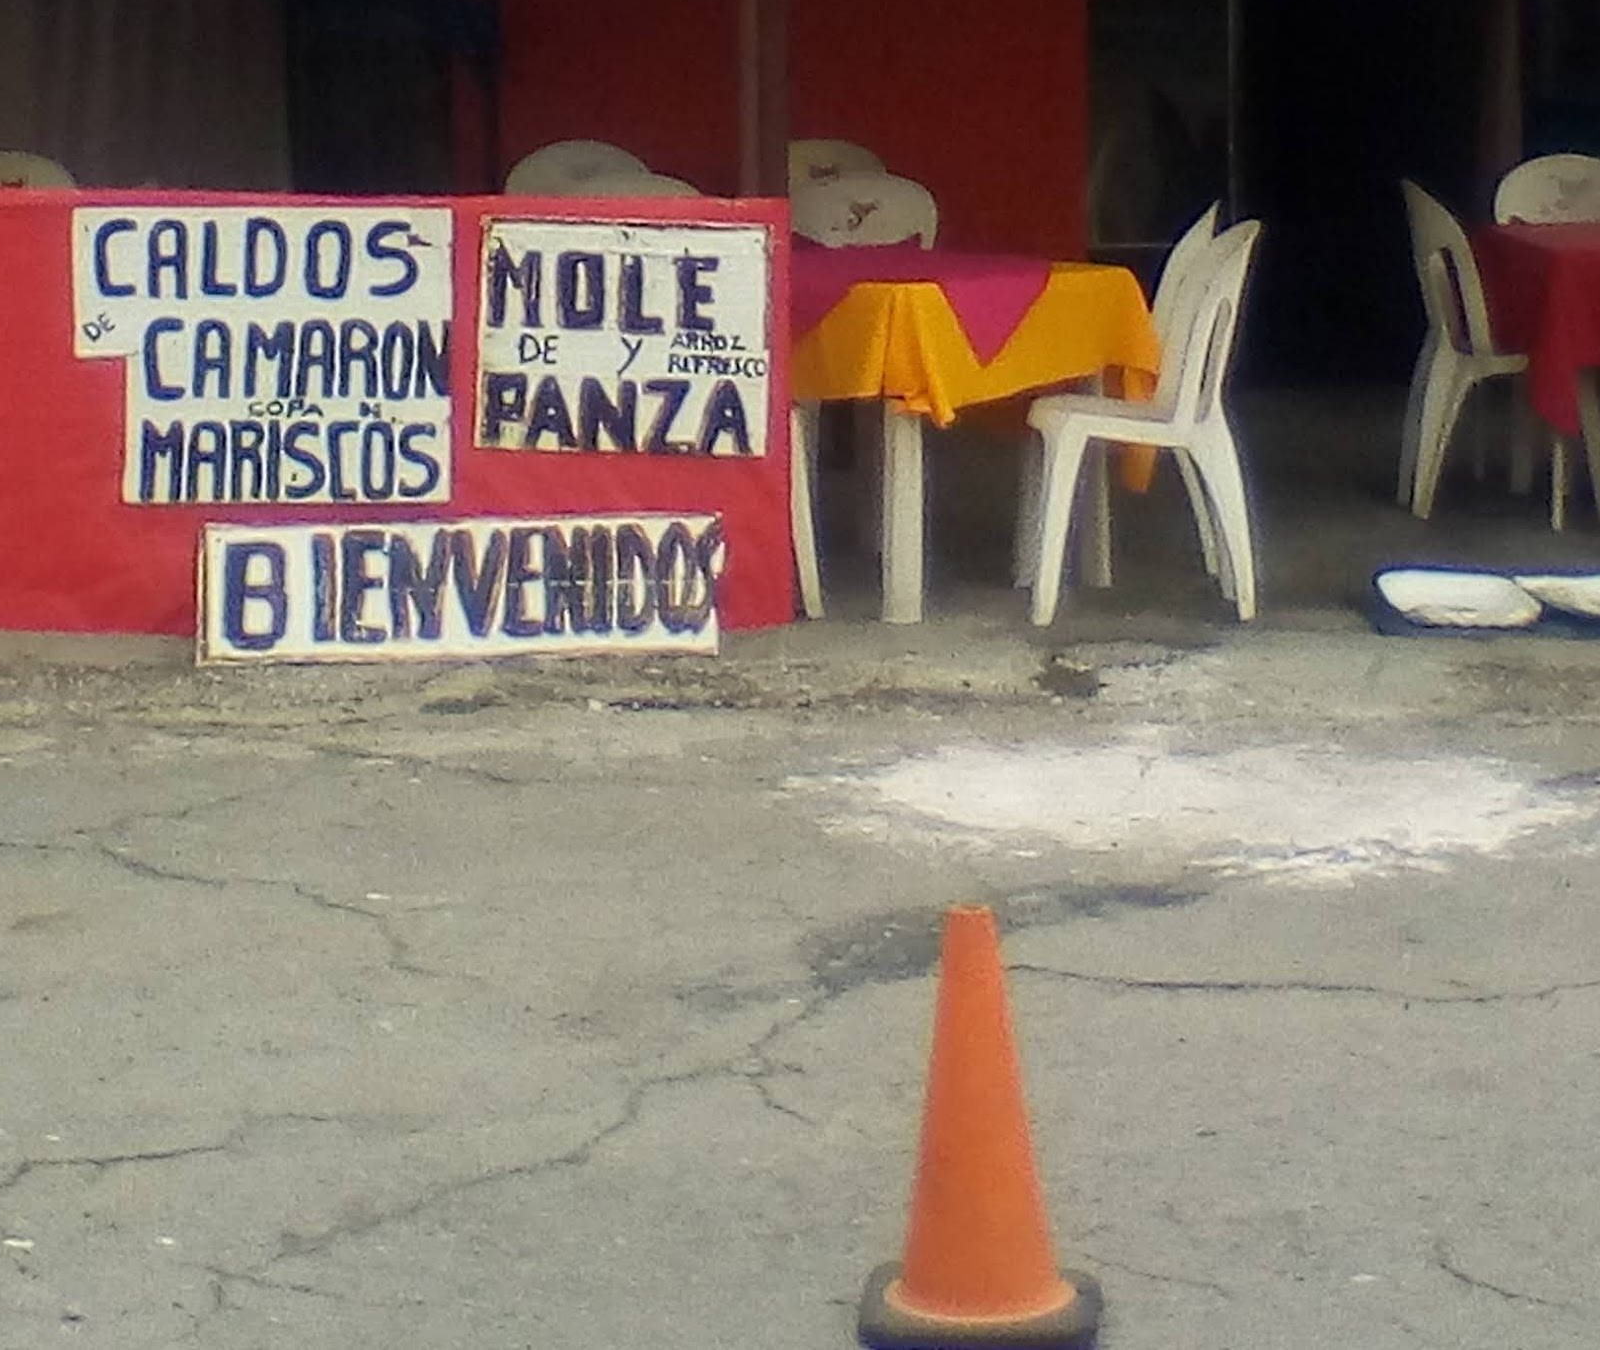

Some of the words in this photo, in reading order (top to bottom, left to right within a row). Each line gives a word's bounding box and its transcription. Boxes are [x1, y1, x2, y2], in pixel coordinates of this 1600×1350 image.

[95, 218, 420, 300] CALDOS
[486, 236, 720, 334] MOLE
[81, 311, 117, 343] DE
[143, 317, 451, 400] CAMARON
[518, 333, 560, 365] DE
[247, 400, 325, 419] COPA
[483, 372, 753, 457] PANZA
[138, 419, 441, 502] MARISCOS
